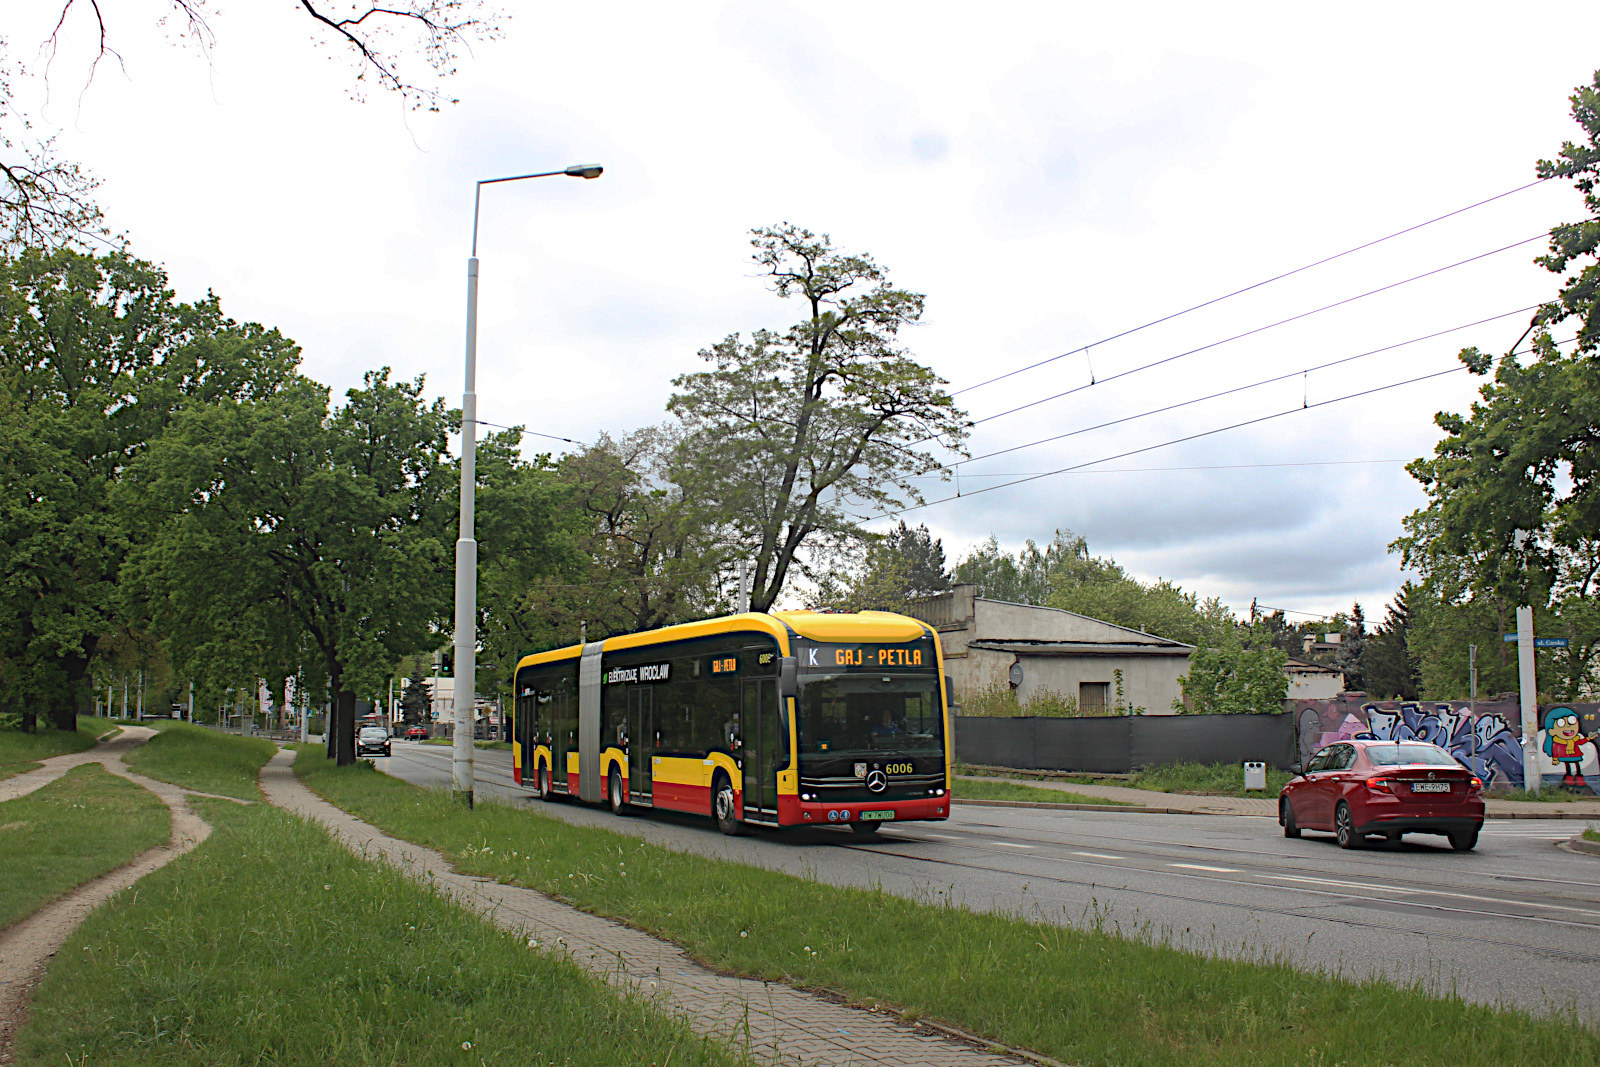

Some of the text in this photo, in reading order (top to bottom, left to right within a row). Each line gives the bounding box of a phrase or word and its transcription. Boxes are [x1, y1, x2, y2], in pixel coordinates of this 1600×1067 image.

[809, 648, 819, 665] K
[835, 649, 863, 665] GAJ
[885, 763, 913, 775] 6006
